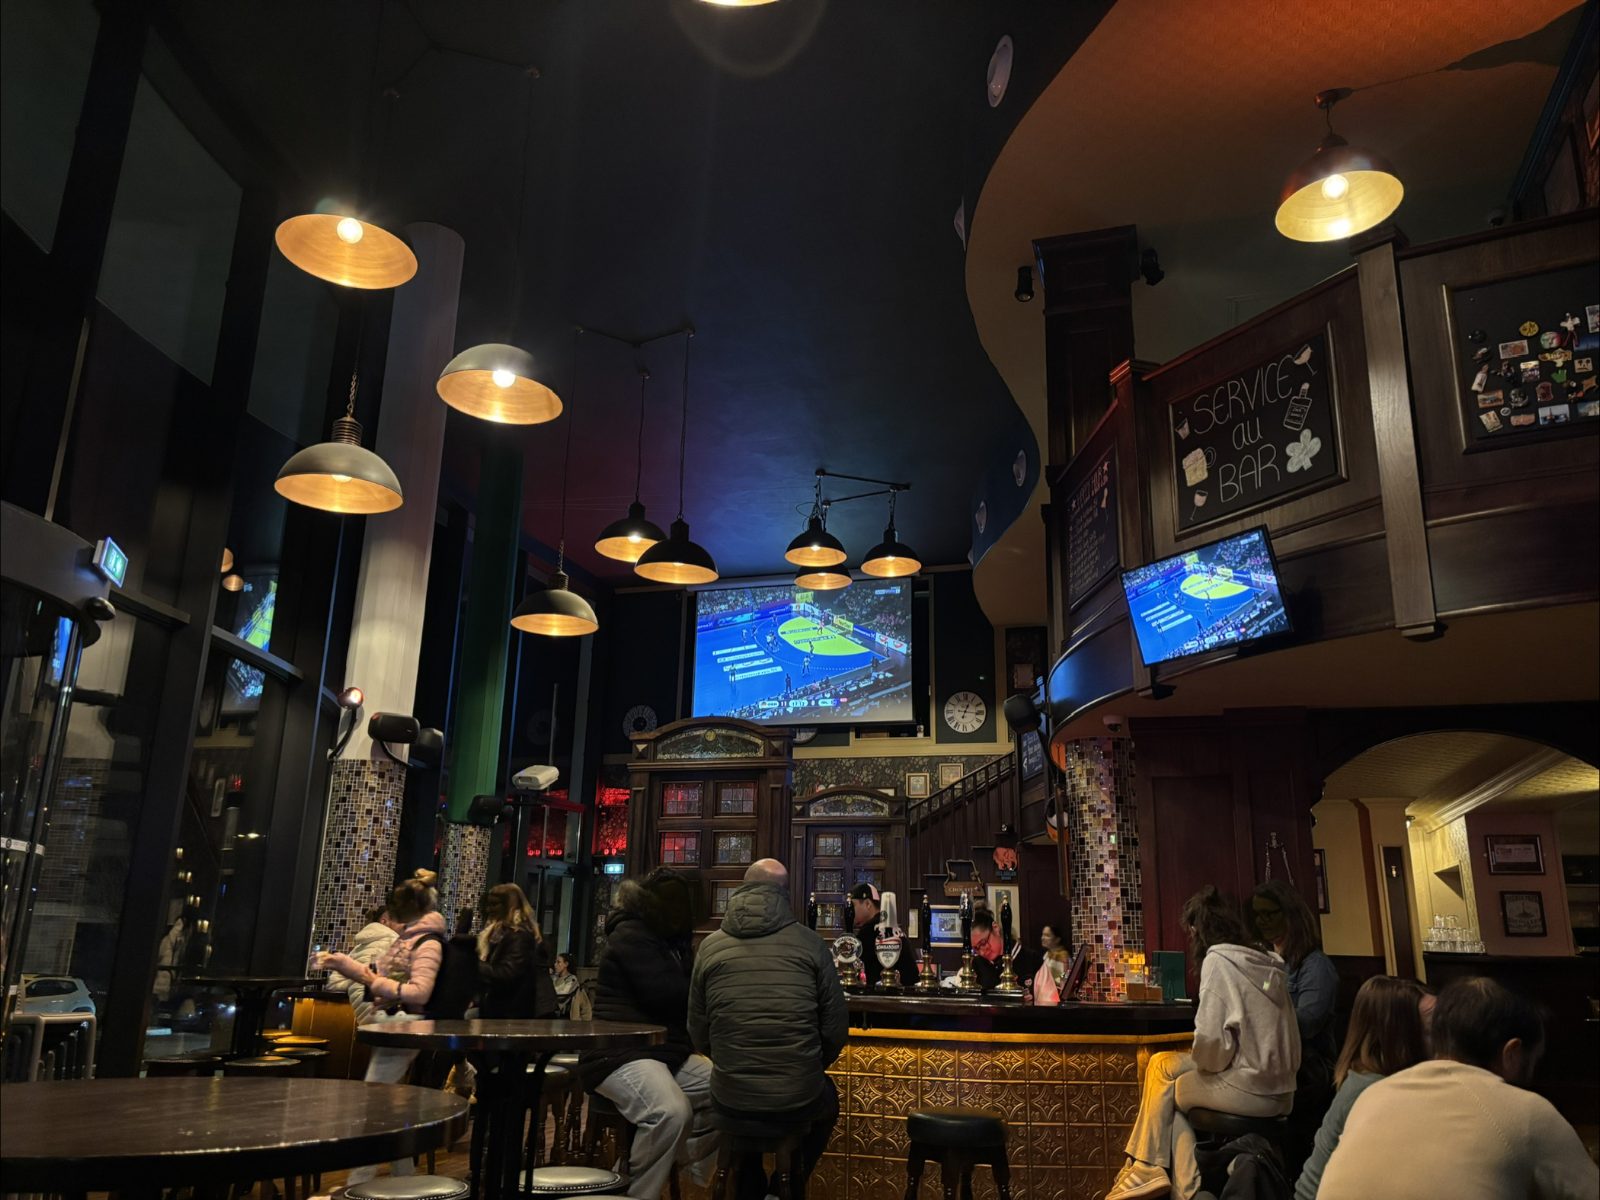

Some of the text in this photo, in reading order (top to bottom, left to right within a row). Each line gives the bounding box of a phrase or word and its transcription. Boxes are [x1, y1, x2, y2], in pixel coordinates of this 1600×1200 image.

[1193, 354, 1293, 434] SERVICE
[1232, 417, 1263, 450] au
[1218, 443, 1281, 503] BAR
